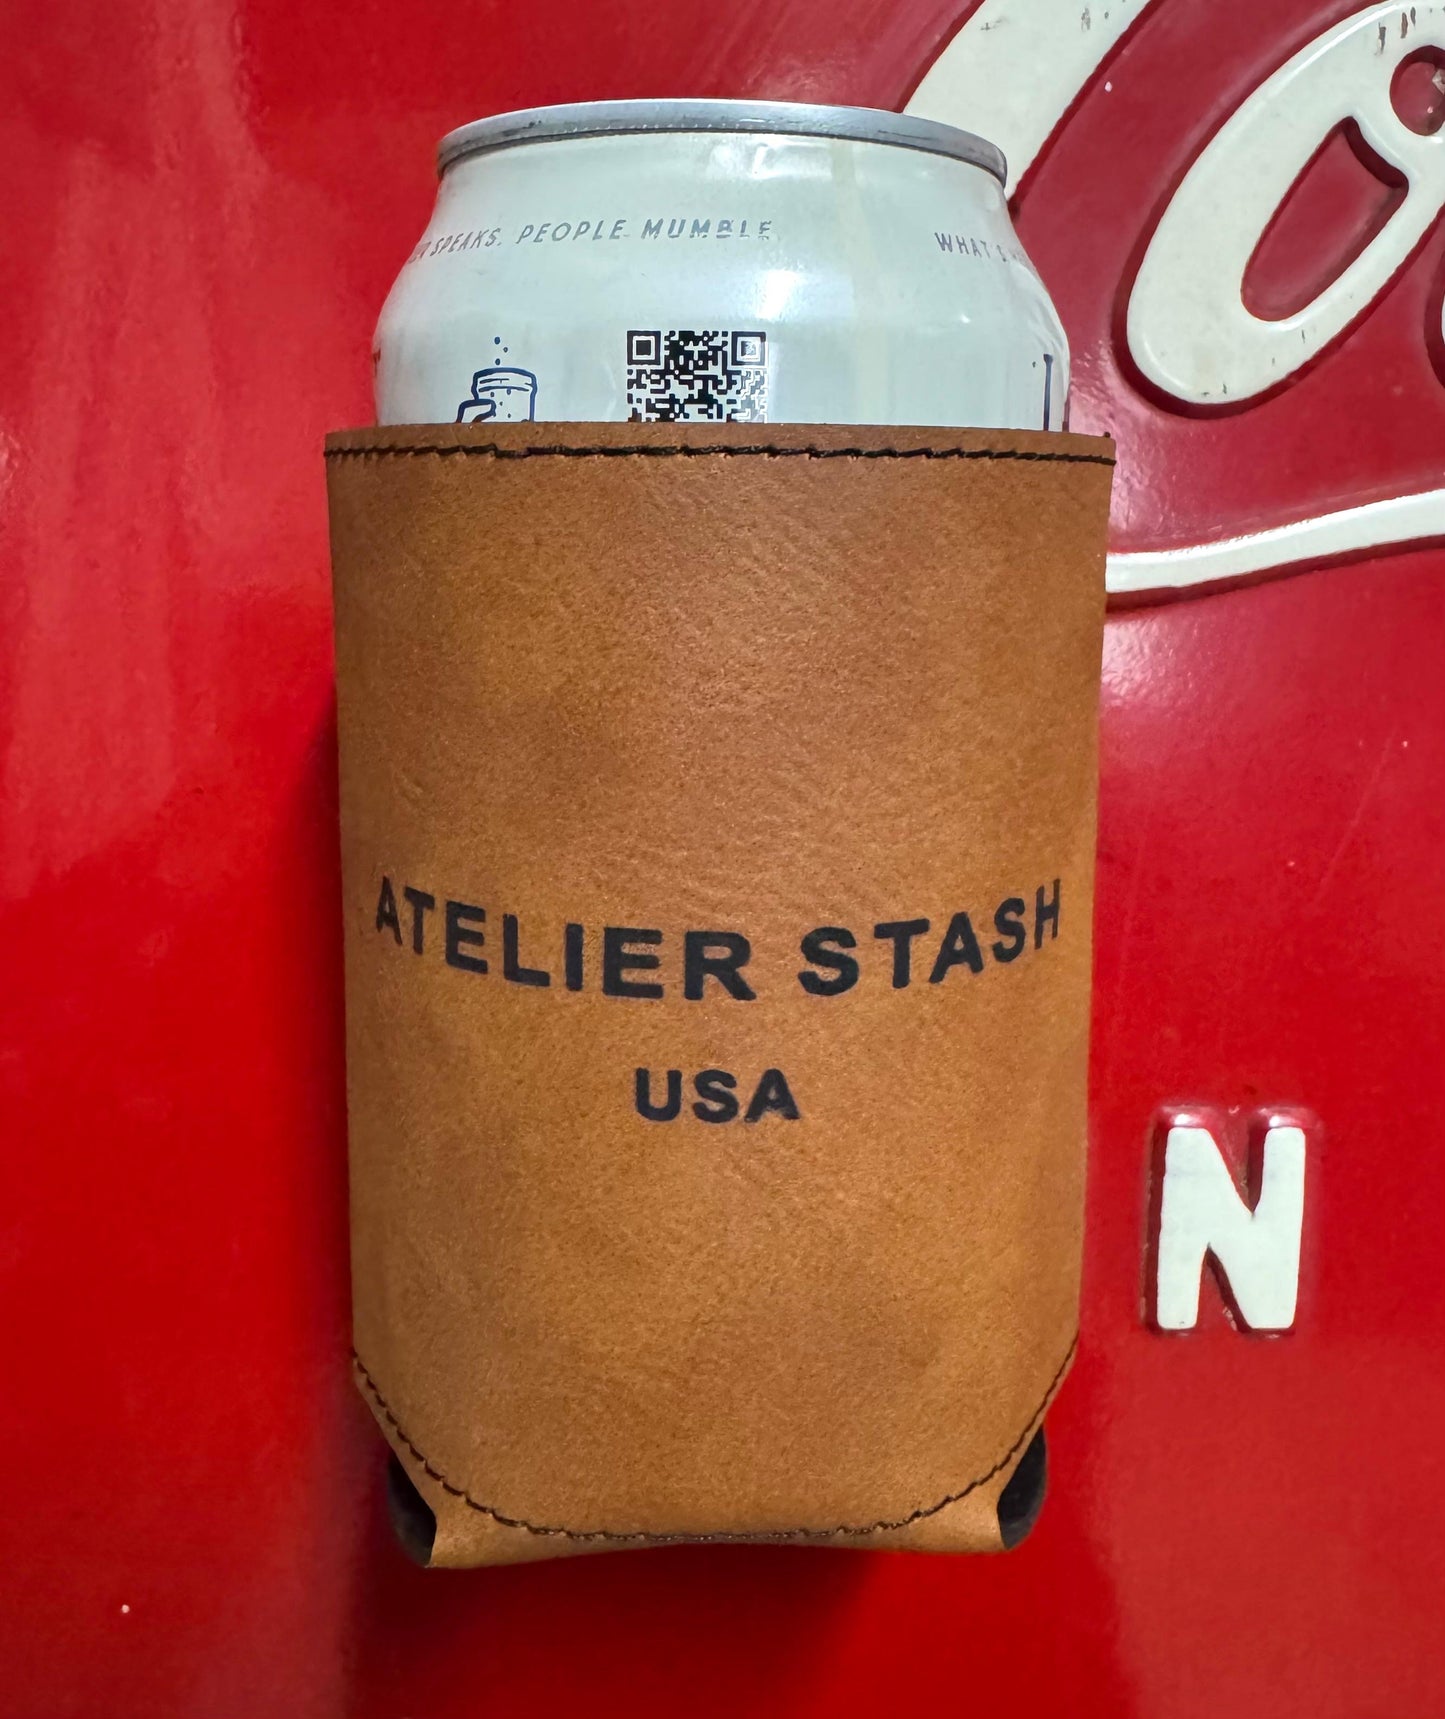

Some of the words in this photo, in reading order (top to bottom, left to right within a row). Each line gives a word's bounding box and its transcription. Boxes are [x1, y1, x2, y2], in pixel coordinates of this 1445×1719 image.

[515, 218, 627, 245] PEOPLE
[375, 875, 757, 1001] ATELIER
[797, 878, 1061, 997] STASH
[635, 1067, 800, 1123] USA
